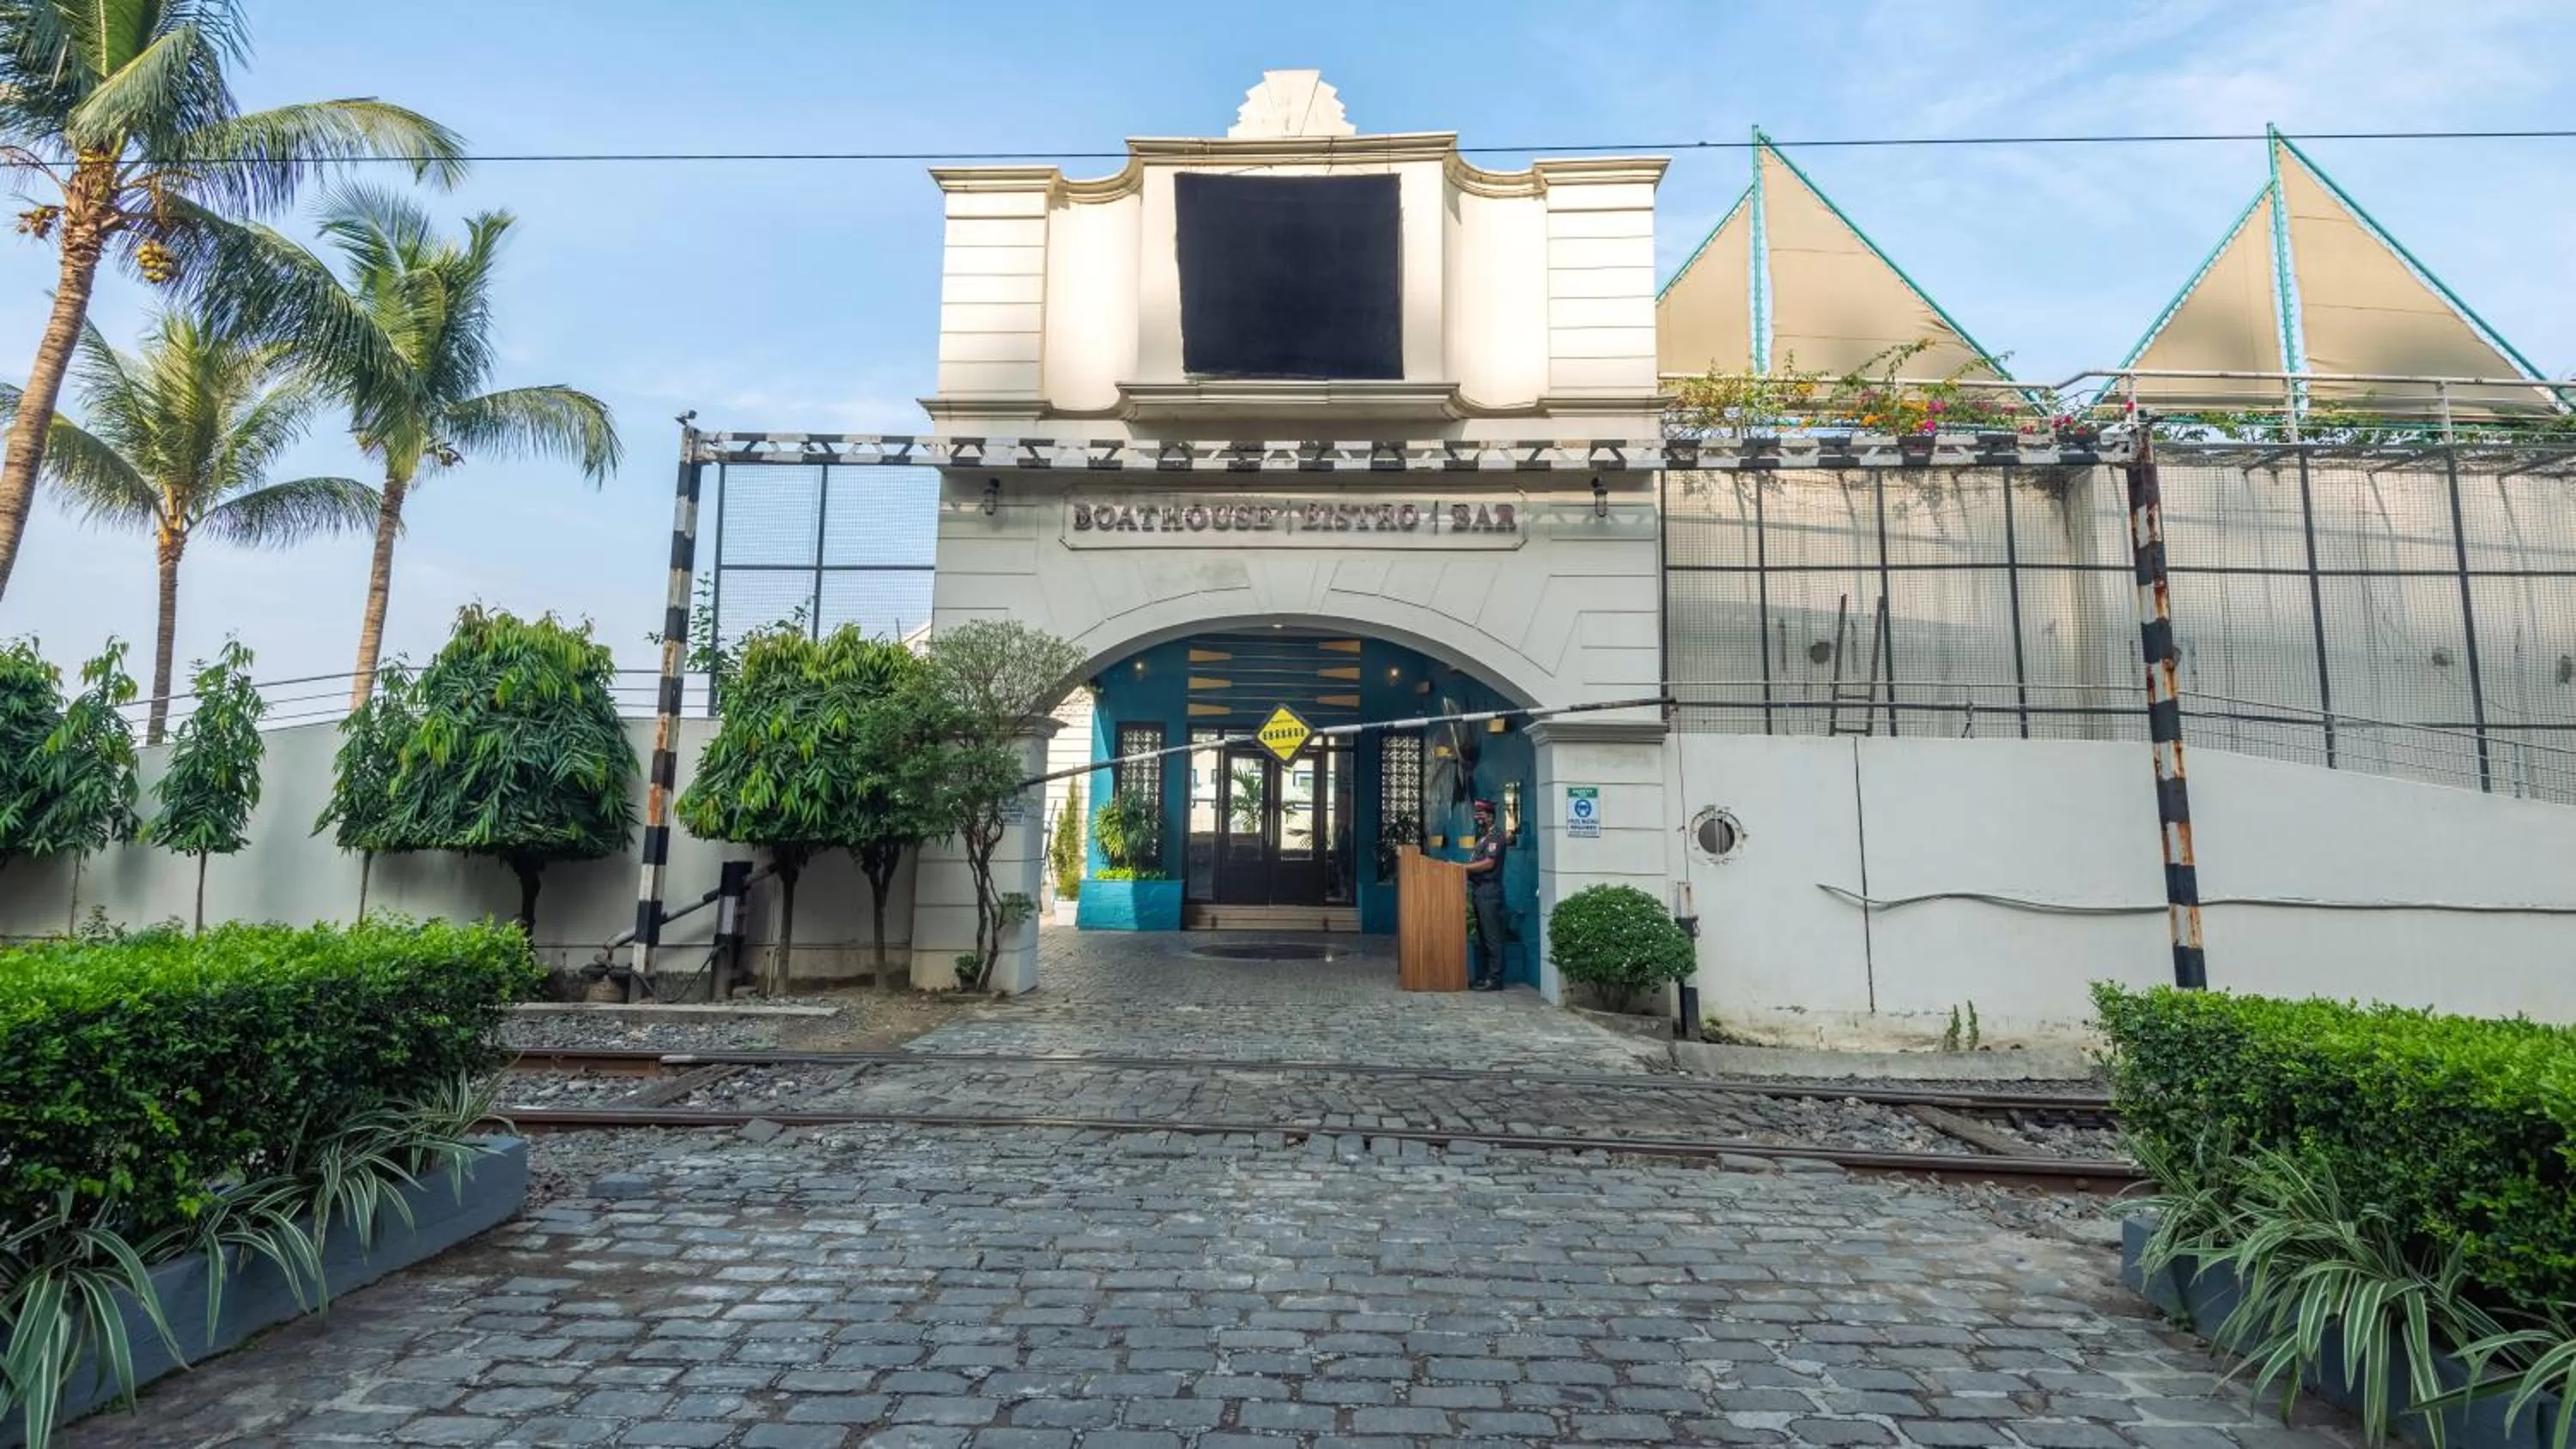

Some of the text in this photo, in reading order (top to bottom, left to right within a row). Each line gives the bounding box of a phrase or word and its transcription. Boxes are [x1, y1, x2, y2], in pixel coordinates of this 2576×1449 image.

[1073, 503, 1517, 532] BOATHOUSE BISTRO BAR
